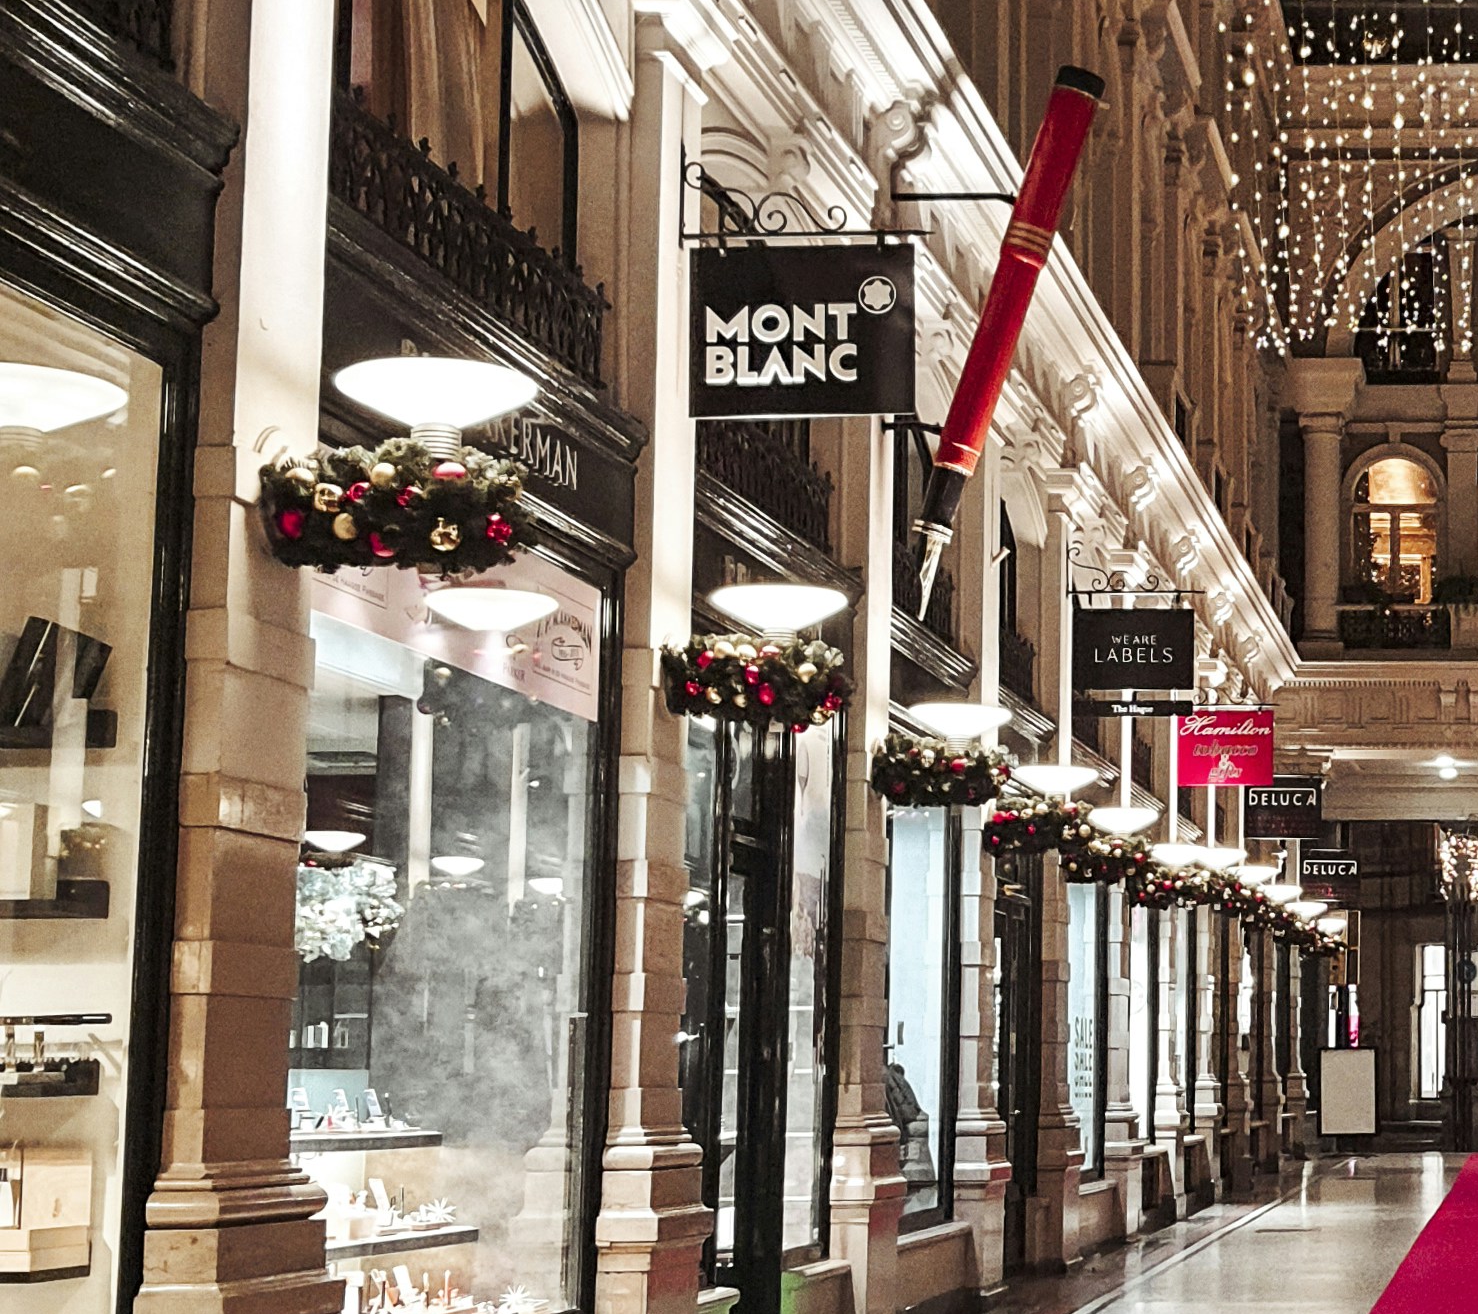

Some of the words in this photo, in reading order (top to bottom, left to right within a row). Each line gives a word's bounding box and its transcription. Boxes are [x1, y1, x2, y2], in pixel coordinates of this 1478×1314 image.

[705, 303, 858, 343] MONT
[705, 343, 858, 385] BLANC
[1111, 634, 1130, 645] WE
[1132, 634, 1157, 645] ARE
[1094, 647, 1173, 663] LABELS
[1111, 704, 1127, 713] The
[1129, 704, 1153, 715] Hague
[1180, 715, 1271, 735] Hamilton
[1248, 791, 1316, 806] DELUCA
[1302, 862, 1358, 875] DELUCA
[1075, 1016, 1092, 1049] SALE
